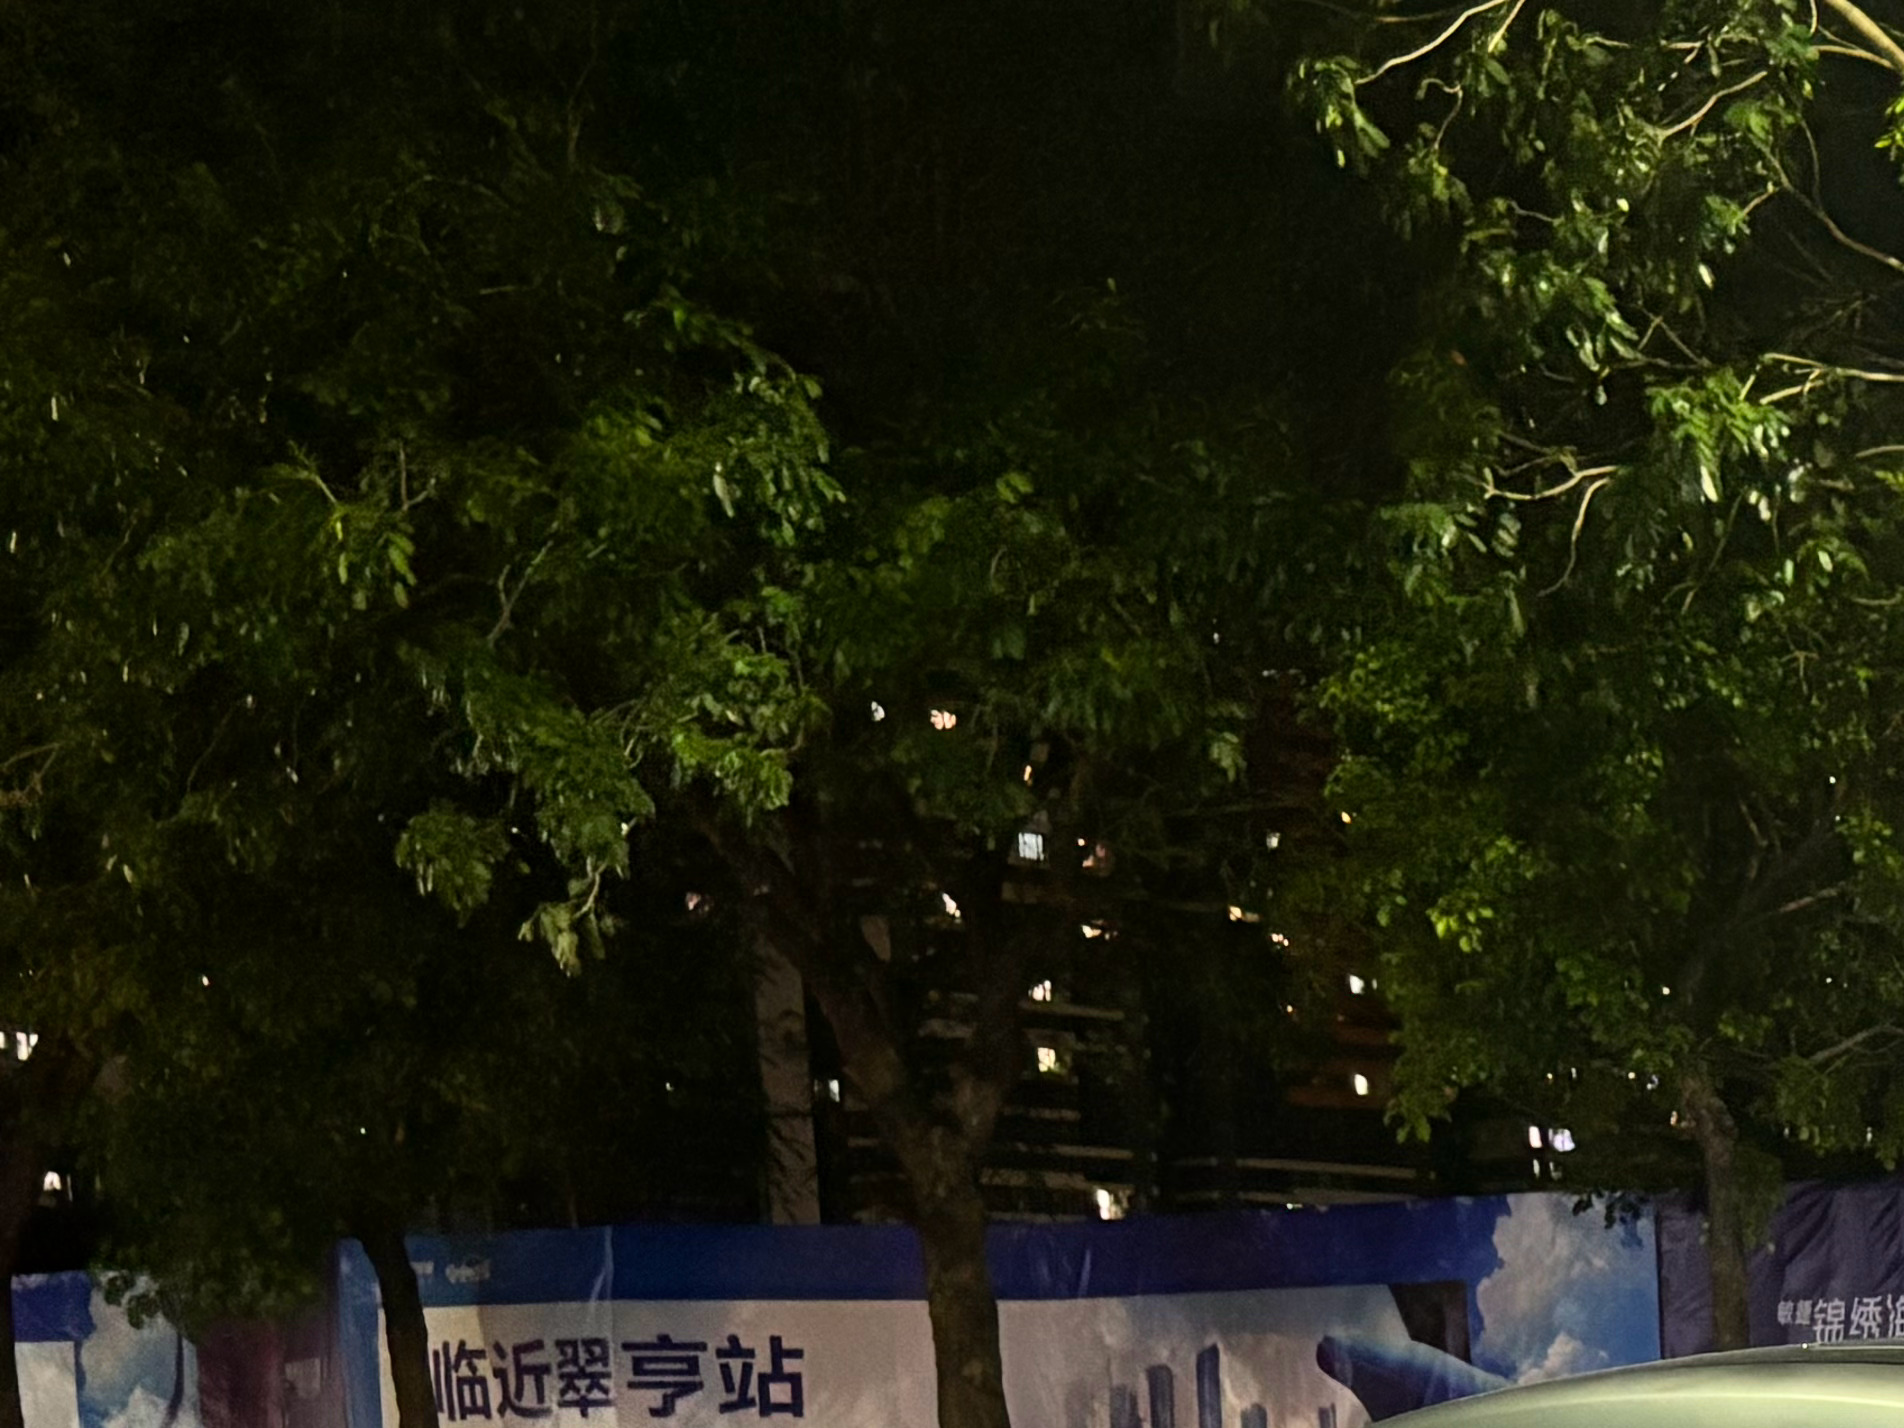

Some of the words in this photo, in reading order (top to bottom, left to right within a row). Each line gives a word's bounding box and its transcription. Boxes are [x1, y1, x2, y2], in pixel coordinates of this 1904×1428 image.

[432, 1334, 805, 1421] 临近翠亨站
